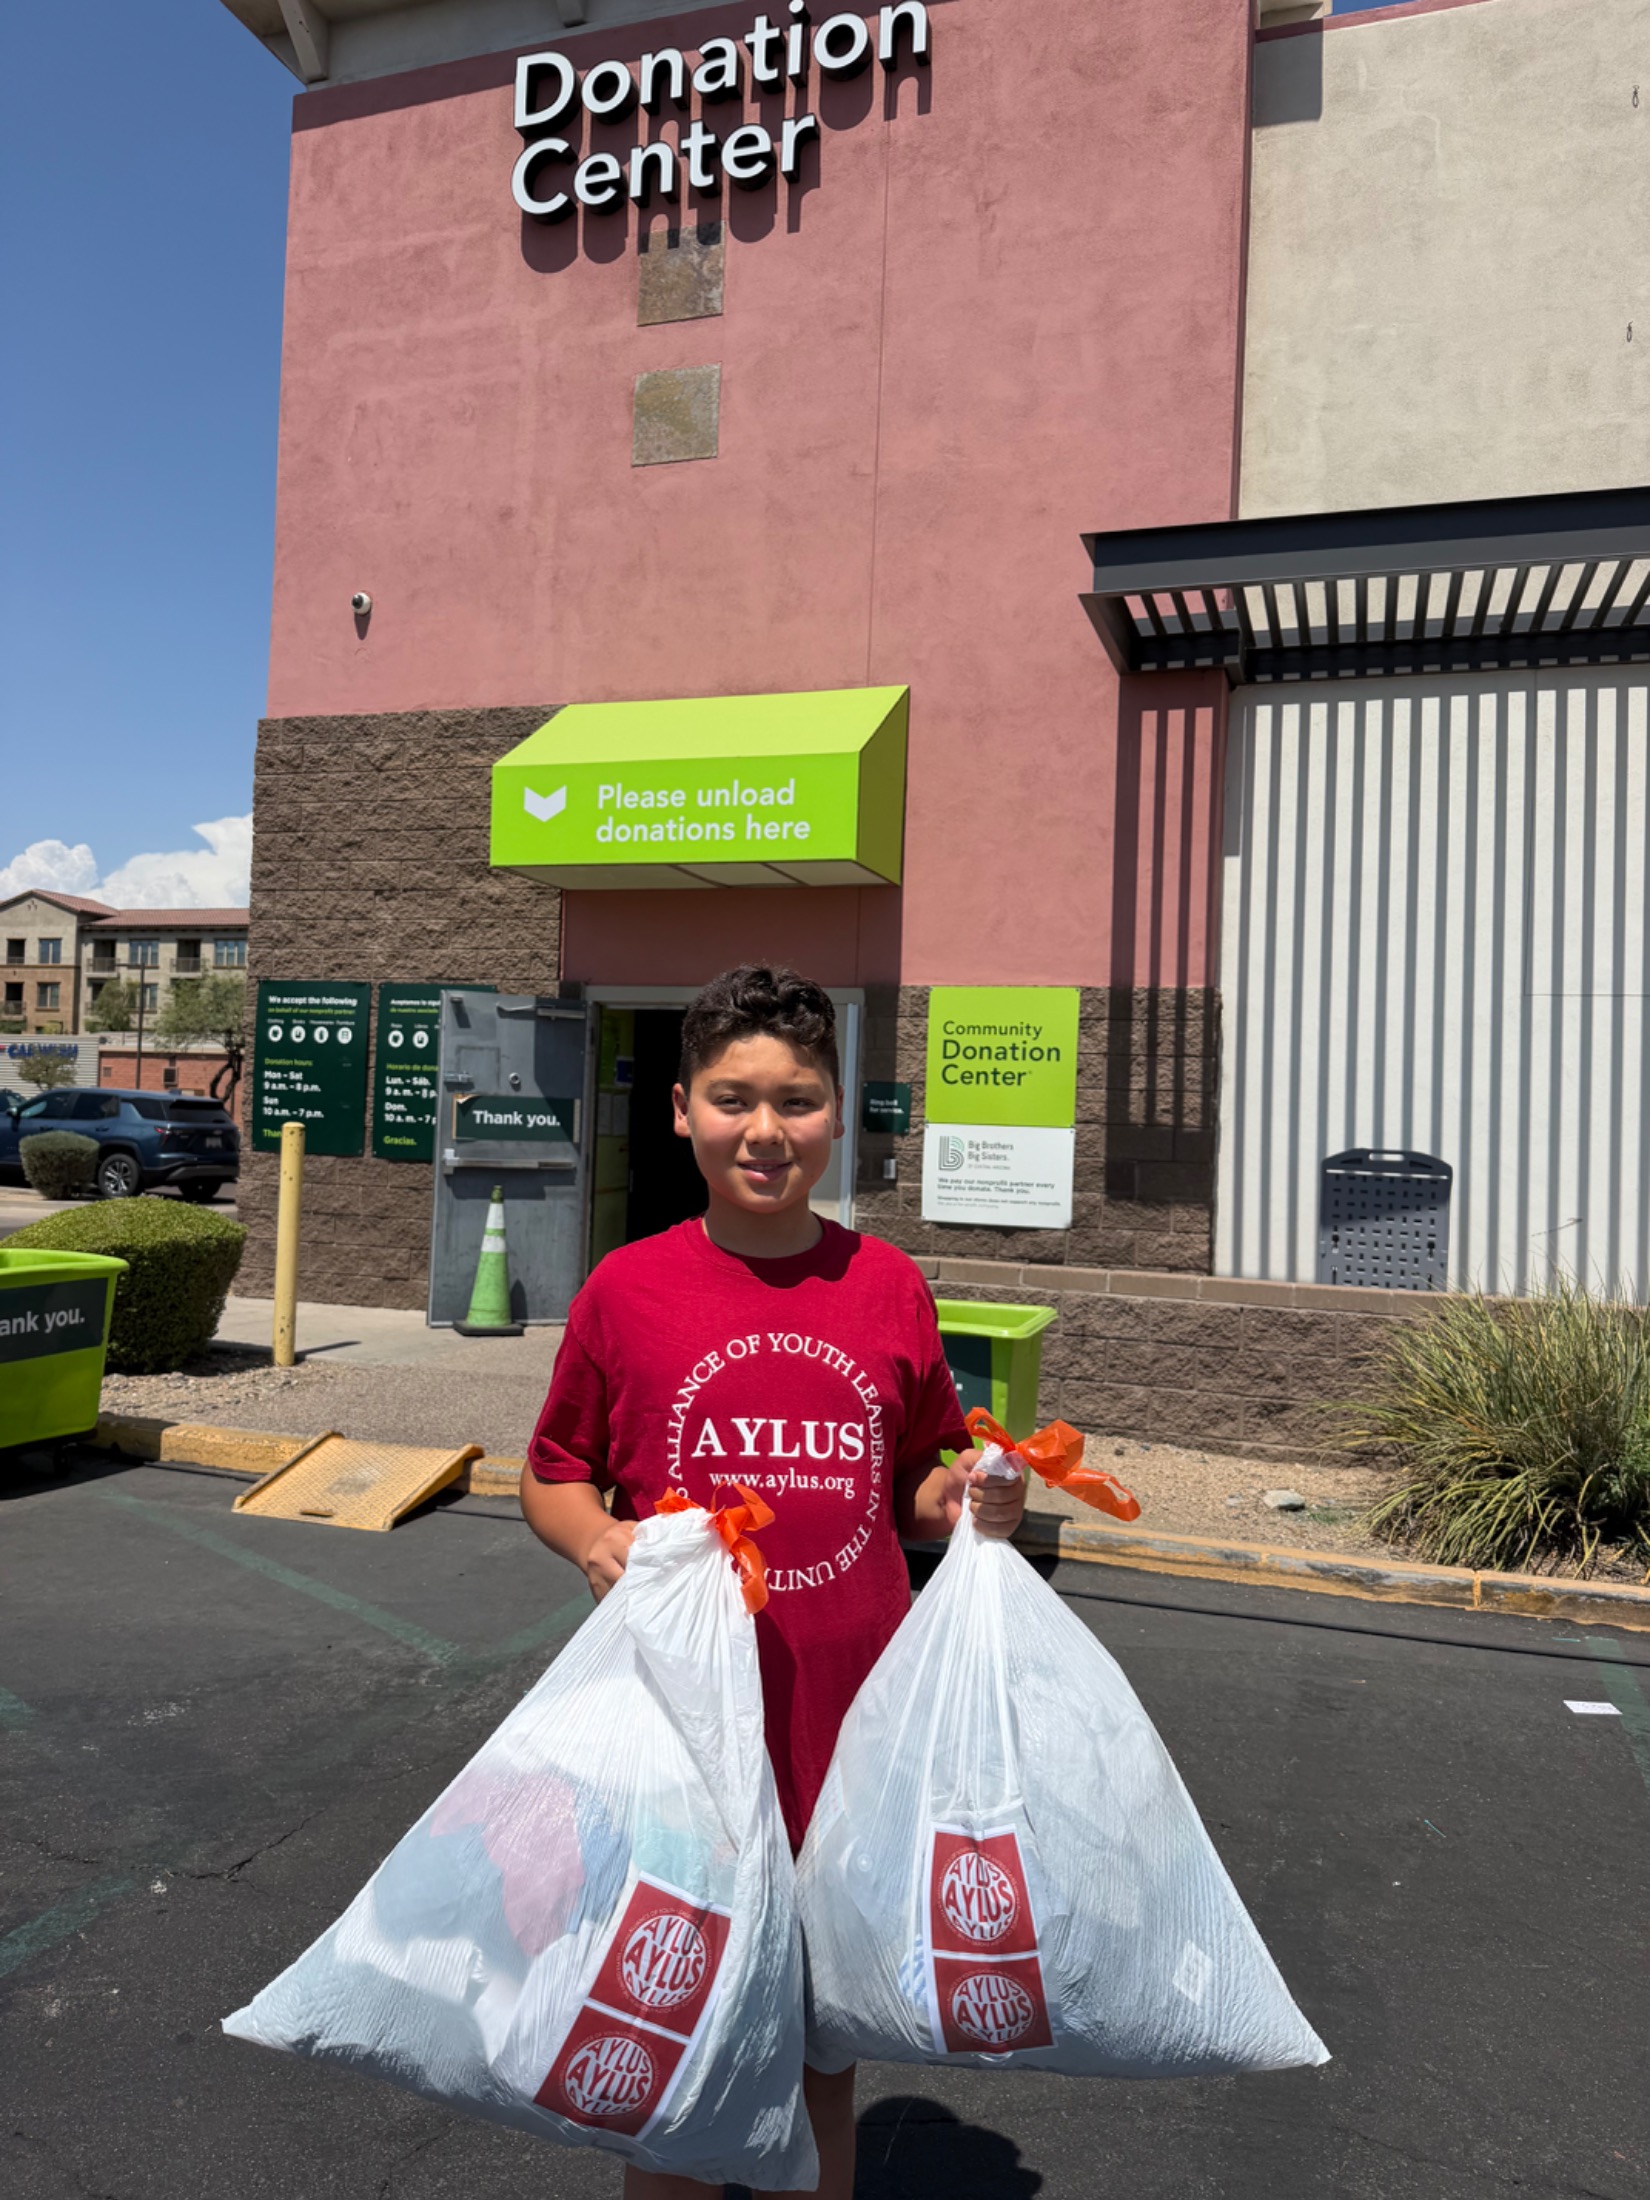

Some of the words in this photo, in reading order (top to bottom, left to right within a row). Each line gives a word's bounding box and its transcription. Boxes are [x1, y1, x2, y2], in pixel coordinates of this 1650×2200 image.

[514, 0, 927, 129] Donation
[511, 113, 816, 215] Center
[597, 782, 686, 809] Please
[697, 778, 796, 807] unload
[596, 816, 735, 843] donations
[745, 813, 811, 841] here
[268, 995, 281, 1004] We
[282, 996, 307, 1006] accept
[308, 996, 321, 1005] the
[321, 997, 358, 1007] following
[942, 1020, 1043, 1040] Community
[264, 1058, 293, 1066] Donation
[942, 1039, 1061, 1062] Donation
[264, 1070, 282, 1079] Mon
[289, 1071, 303, 1080] Sat
[385, 1075, 404, 1085] Lun.
[422, 1064, 440, 1072] dona
[941, 1063, 1026, 1086] Center
[263, 1080, 270, 1090] 9
[271, 1083, 288, 1091] a.m.
[296, 1082, 302, 1091] 8
[303, 1084, 321, 1093] p.m.
[385, 1086, 392, 1096] 9
[263, 1095, 279, 1105] Sun
[263, 1106, 273, 1116] 10
[274, 1108, 291, 1117] a.m.
[298, 1108, 305, 1117] 7
[305, 1109, 324, 1119] p.m.
[384, 1102, 408, 1112] Dom.
[384, 1113, 394, 1122] 10
[424, 1114, 431, 1123] 7
[472, 1110, 523, 1125] Thank
[526, 1114, 561, 1128] you.
[262, 1128, 282, 1138] Than
[383, 1135, 417, 1146] Gracias.
[968, 1140, 980, 1151] Big
[981, 1141, 1014, 1150] Brothers
[967, 1151, 980, 1162] Big
[0, 1310, 39, 1336] ank
[44, 1308, 85, 1334] you.
[726, 1334, 761, 1359] OF
[767, 1333, 857, 1377] YOUTH
[667, 1351, 726, 1481] ALLIANCE
[851, 1370, 885, 1484] LEADERS
[691, 1417, 865, 1461] AYLUS
[709, 1468, 855, 1500] www.aylus.org
[866, 1489, 880, 1522] IN
[835, 1524, 872, 1571] THE
[764, 1560, 836, 1592] UNIT
[945, 1879, 1014, 1923] AYLUS
[643, 1917, 703, 1956] AYLUS
[624, 1935, 704, 1992] AYLUS
[957, 1976, 1021, 2002] AYLUS
[957, 1995, 1032, 2030] AYLUS
[587, 2039, 650, 2074] AYLUS
[567, 2055, 650, 2104] AYLUS
